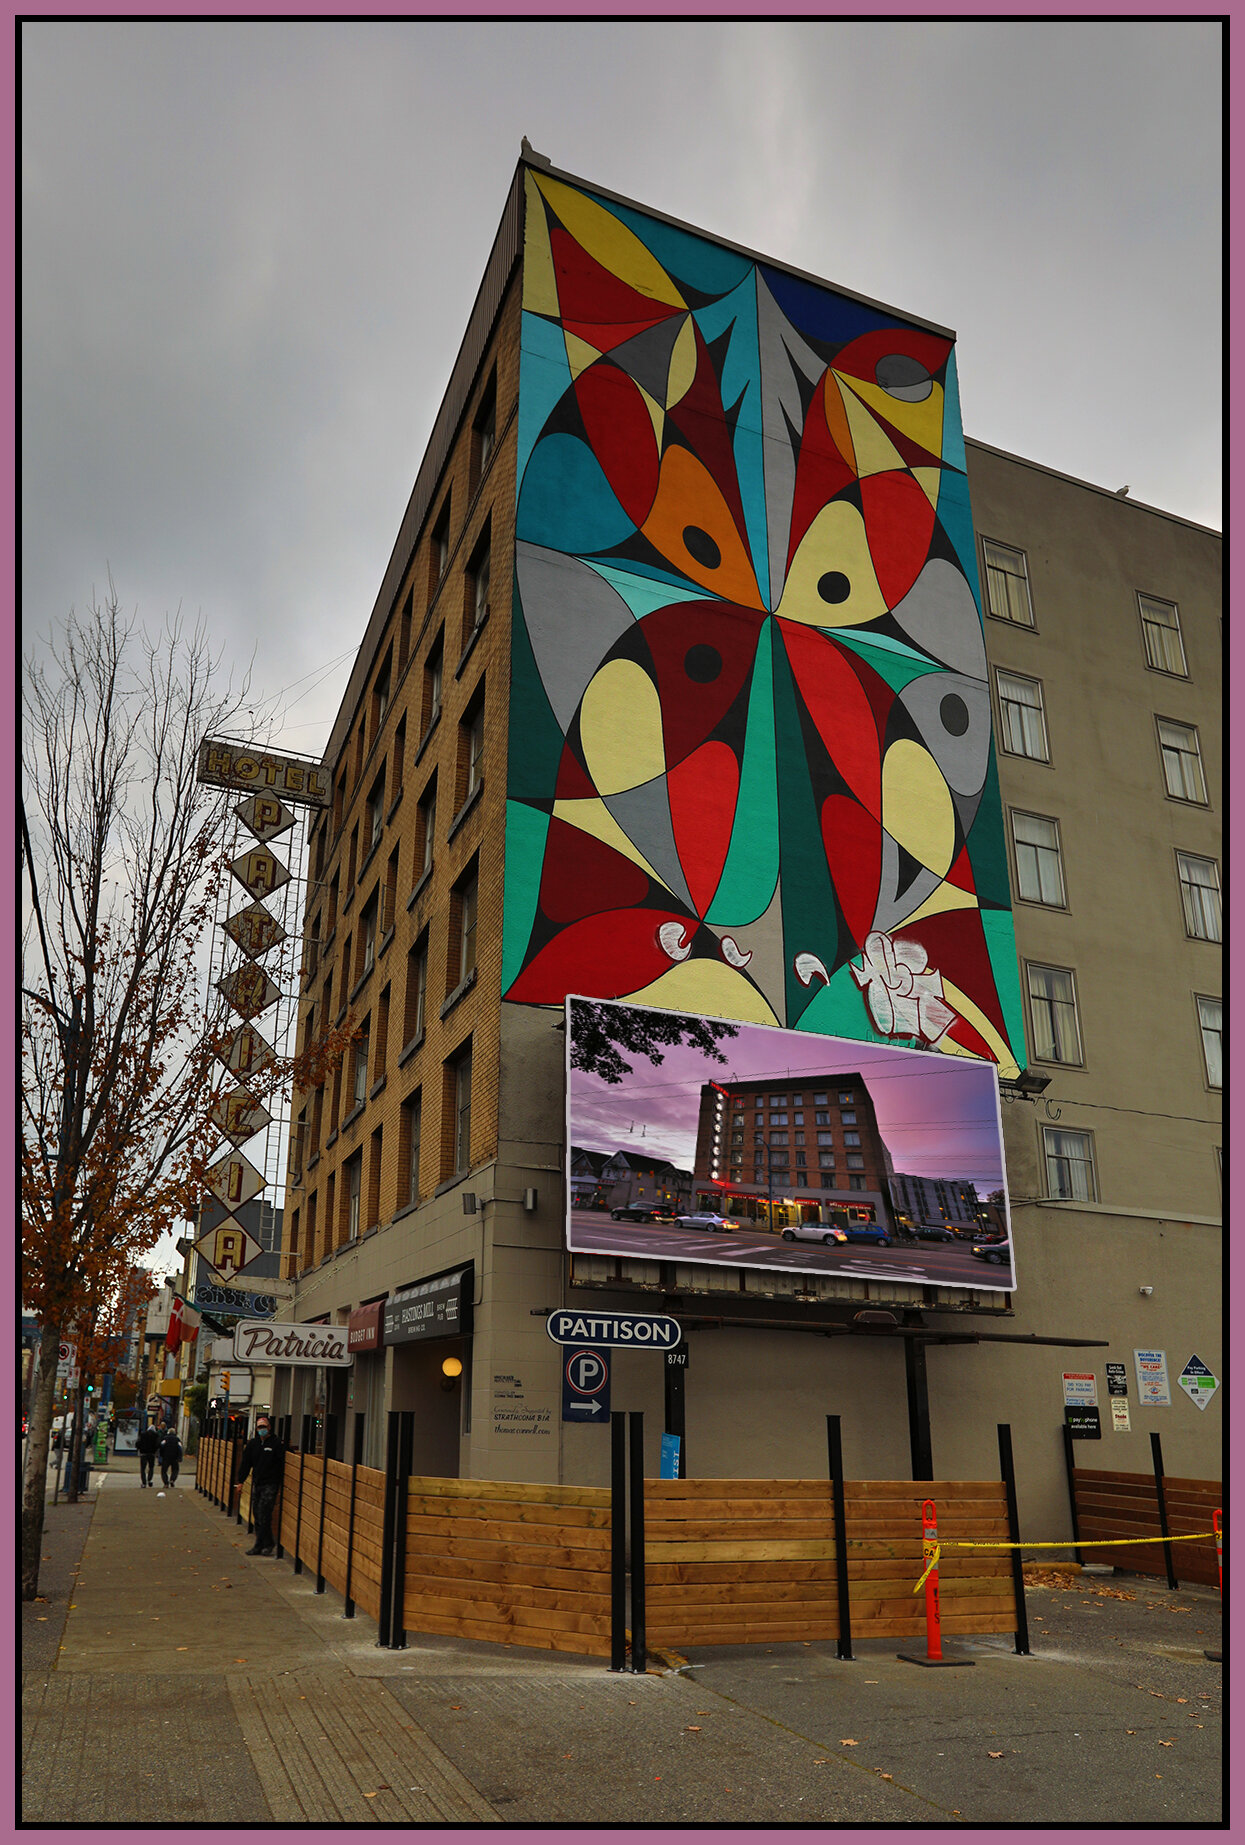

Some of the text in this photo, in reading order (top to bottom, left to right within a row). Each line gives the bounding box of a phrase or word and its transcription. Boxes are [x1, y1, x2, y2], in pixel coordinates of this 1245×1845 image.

[206, 748, 326, 797] HOTEL
[350, 1327, 375, 1344] BUDGET INN
[559, 1317, 670, 1342] PATTISON
[243, 1328, 345, 1360] Patricia
[667, 1354, 686, 1365] 8747
[579, 1358, 599, 1388] P
[494, 1413, 536, 1421] STRATHCONA
